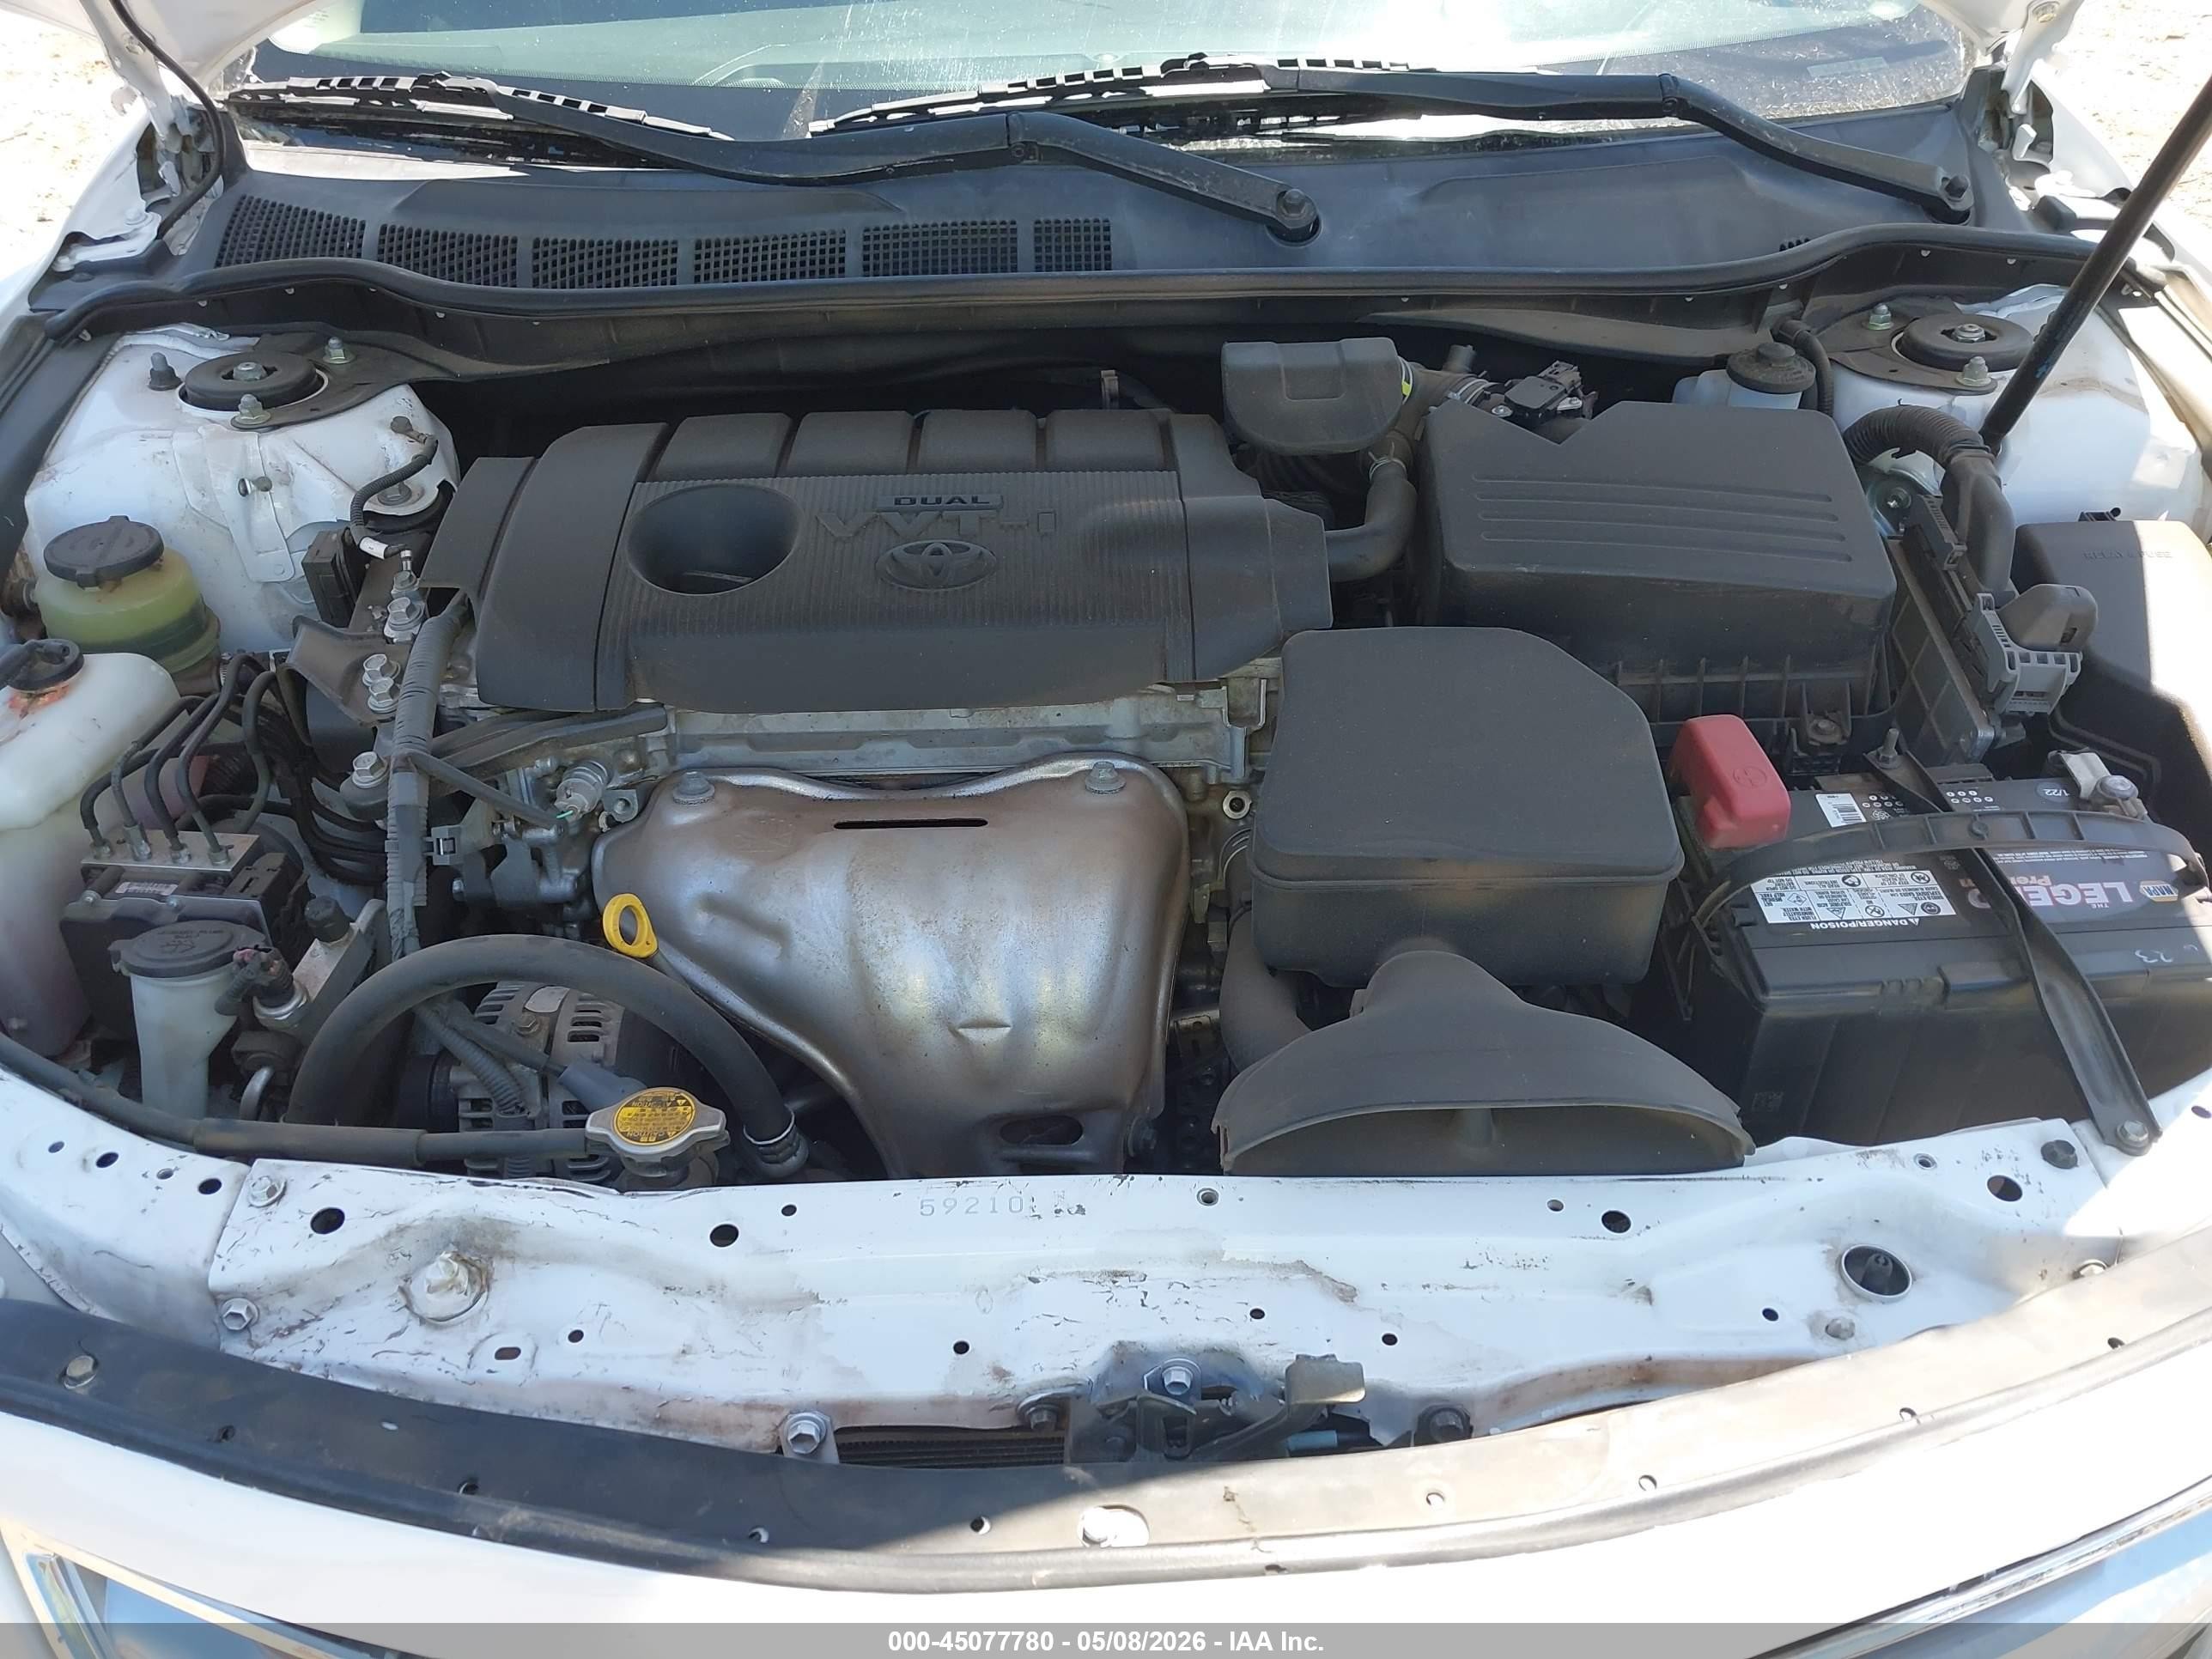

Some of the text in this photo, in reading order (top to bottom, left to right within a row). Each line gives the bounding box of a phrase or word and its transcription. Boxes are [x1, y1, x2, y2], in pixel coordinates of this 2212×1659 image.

[894, 495, 990, 506] DUAL
[2043, 788, 2070, 797] 1/22
[1967, 881, 2133, 908] LEGED
[2143, 885, 2174, 896] NAPA
[1810, 919, 1908, 930] DANGER/POISON
